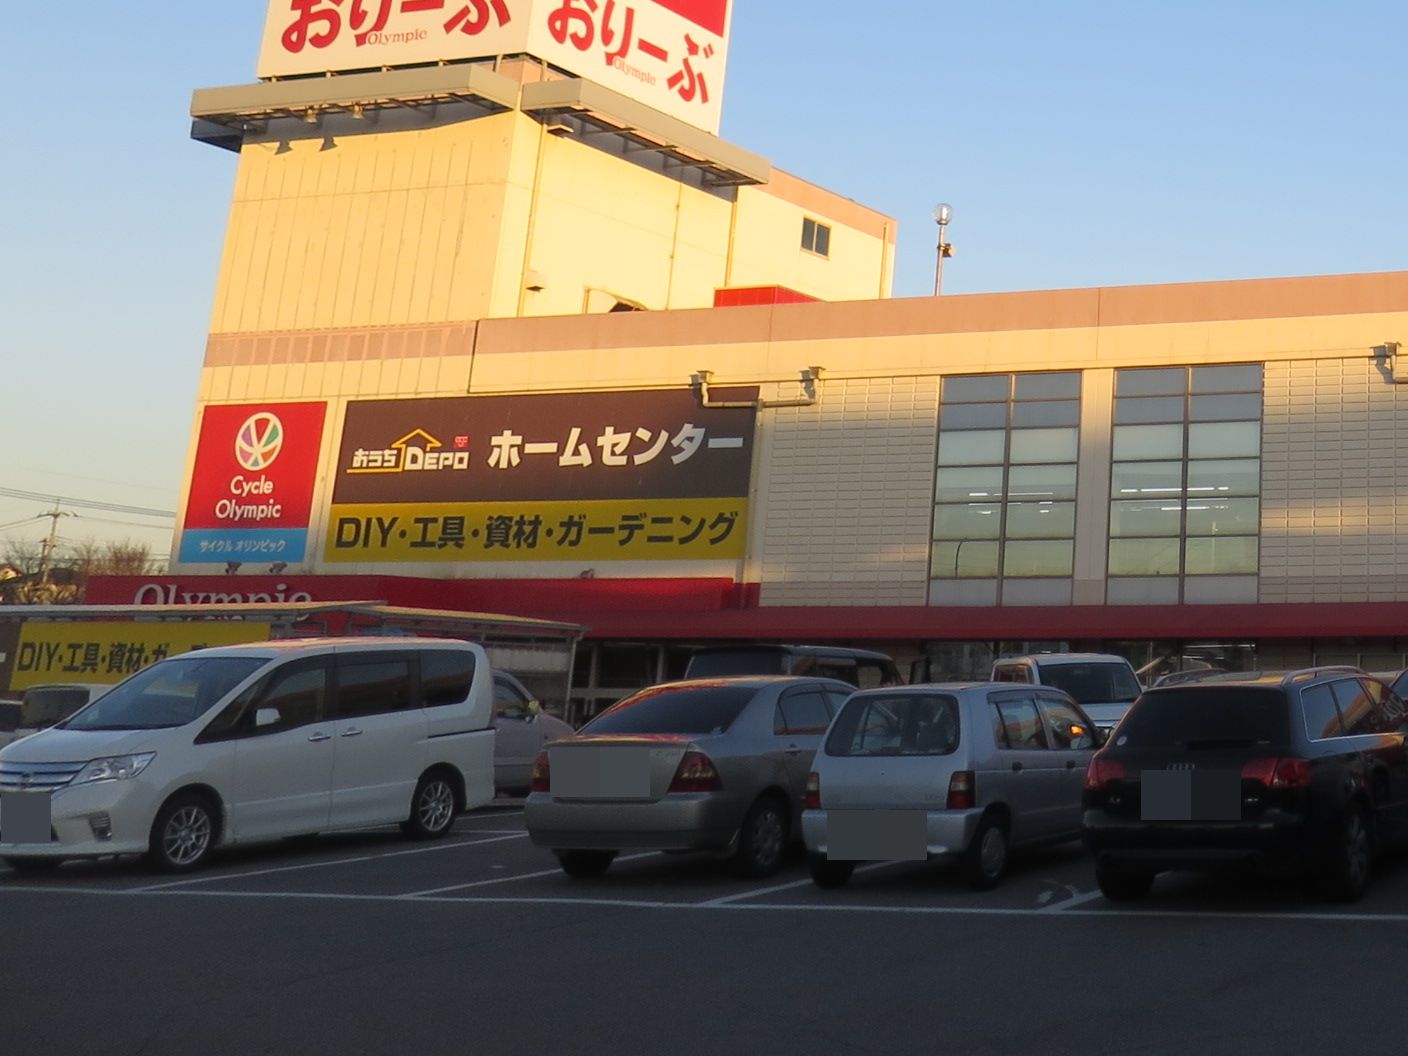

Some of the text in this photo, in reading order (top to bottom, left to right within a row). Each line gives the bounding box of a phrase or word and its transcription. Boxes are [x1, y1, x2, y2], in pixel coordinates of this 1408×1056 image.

[366, 27, 428, 47] Olympic
[612, 54, 657, 87] Olympic
[487, 422, 744, 470] ホームセンター
[229, 475, 274, 497] Cycle
[214, 498, 282, 522] Olympic
